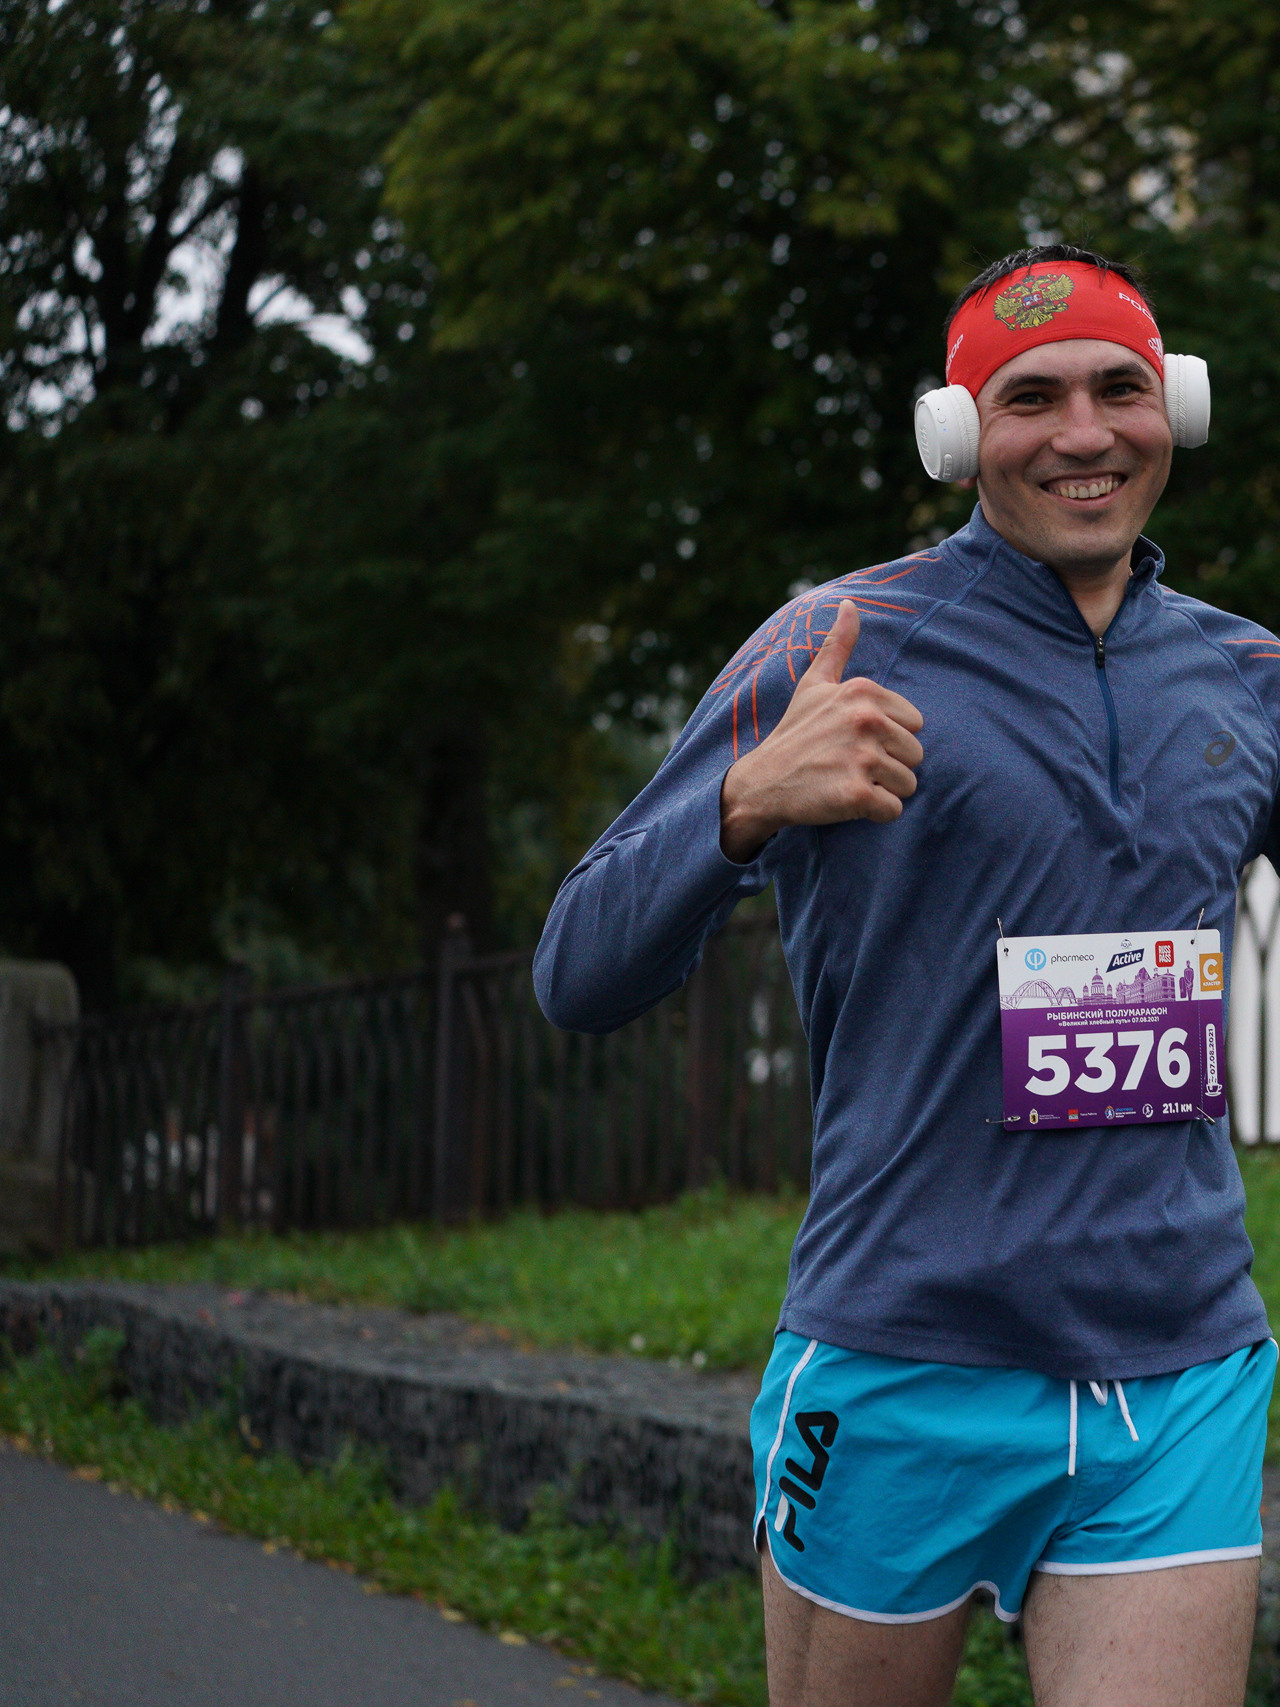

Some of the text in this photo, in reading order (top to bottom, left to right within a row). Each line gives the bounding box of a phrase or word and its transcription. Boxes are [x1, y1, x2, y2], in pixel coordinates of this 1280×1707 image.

[1050, 953, 1095, 965] pharmeco
[1112, 951, 1142, 967] Active
[1046, 1007, 1168, 1021] РЫБИНСКИЙ ПОЛУМАРАФОН
[1131, 1016, 1160, 1024] 07.08.2021
[1208, 1028, 1216, 1075] 07.08.2021
[1025, 1027, 1191, 1096] 5376
[1162, 1102, 1179, 1114] 21.1
[774, 1410, 839, 1552] FILA
